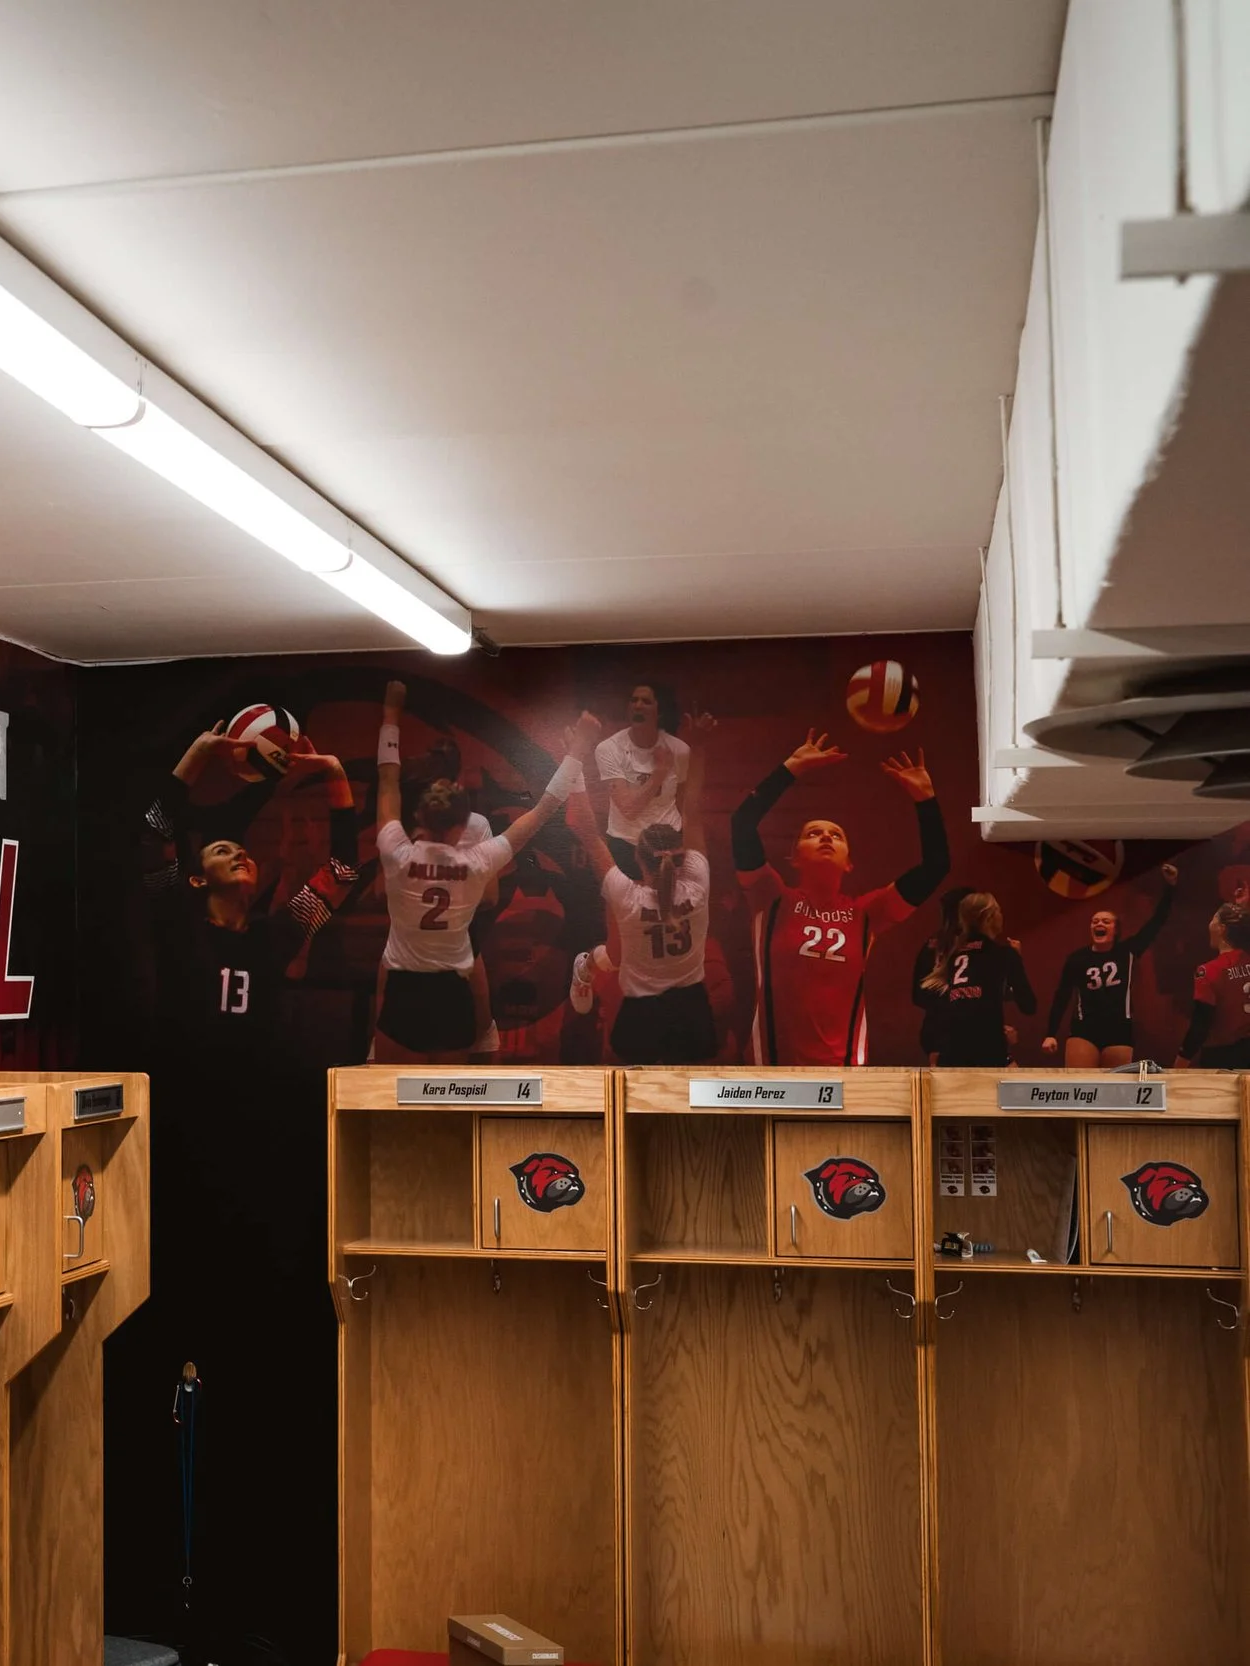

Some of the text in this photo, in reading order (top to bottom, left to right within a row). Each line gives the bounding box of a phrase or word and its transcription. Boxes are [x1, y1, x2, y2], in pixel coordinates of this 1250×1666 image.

[419, 887, 450, 931] 2
[643, 919, 692, 959] 13
[799, 925, 846, 963] 22
[953, 954, 969, 985] 2
[1086, 961, 1121, 991] 32
[220, 967, 250, 1013] 13
[422, 1082, 530, 1099] Kara Pospisil 14
[717, 1086, 834, 1103] Jaiden Perez 13
[1030, 1087, 1152, 1105] Peyton Vogl 12
